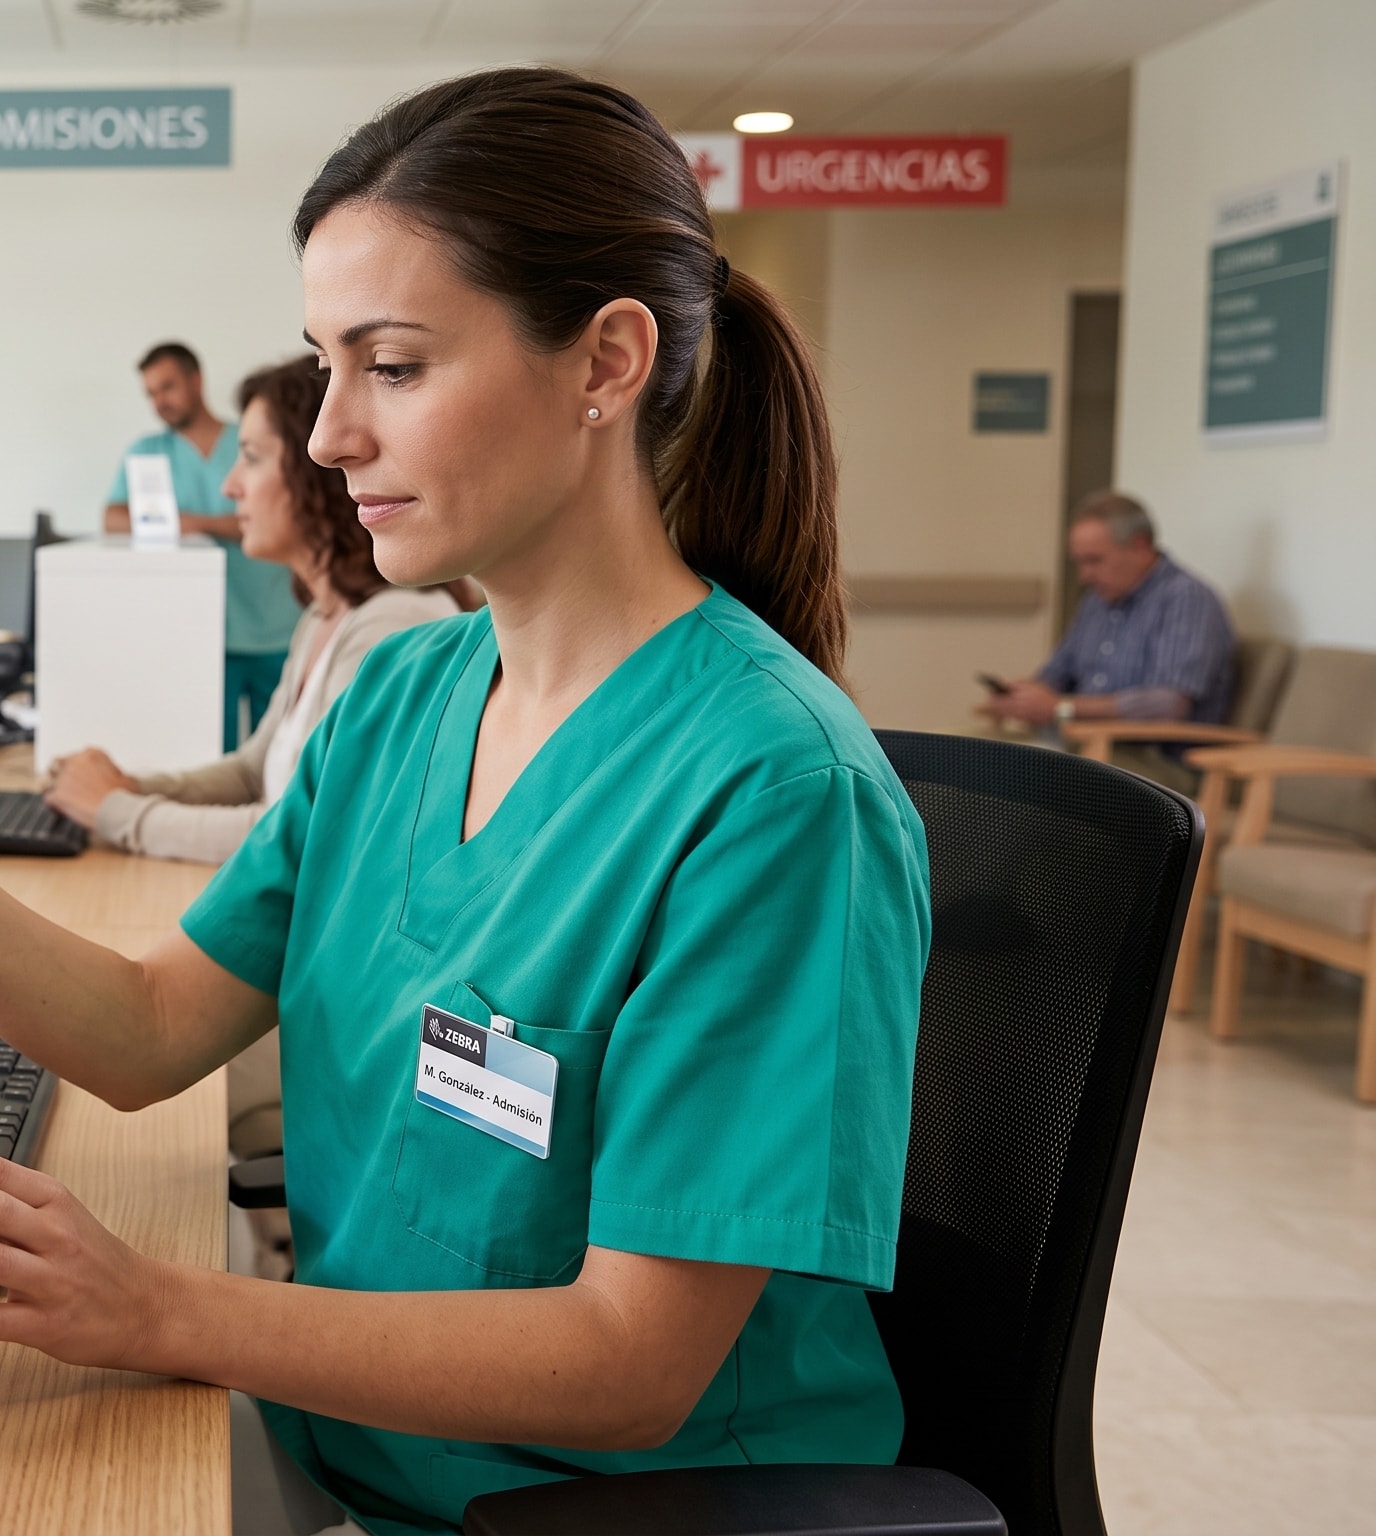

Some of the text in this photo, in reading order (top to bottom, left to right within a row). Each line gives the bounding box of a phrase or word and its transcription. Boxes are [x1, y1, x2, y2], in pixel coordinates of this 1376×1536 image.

[755, 149, 991, 193] URGENCIAS
[445, 1028, 481, 1054] ZEBRA
[424, 1064, 436, 1079] M.
[438, 1070, 485, 1101] González
[492, 1094, 543, 1126] Admisión
